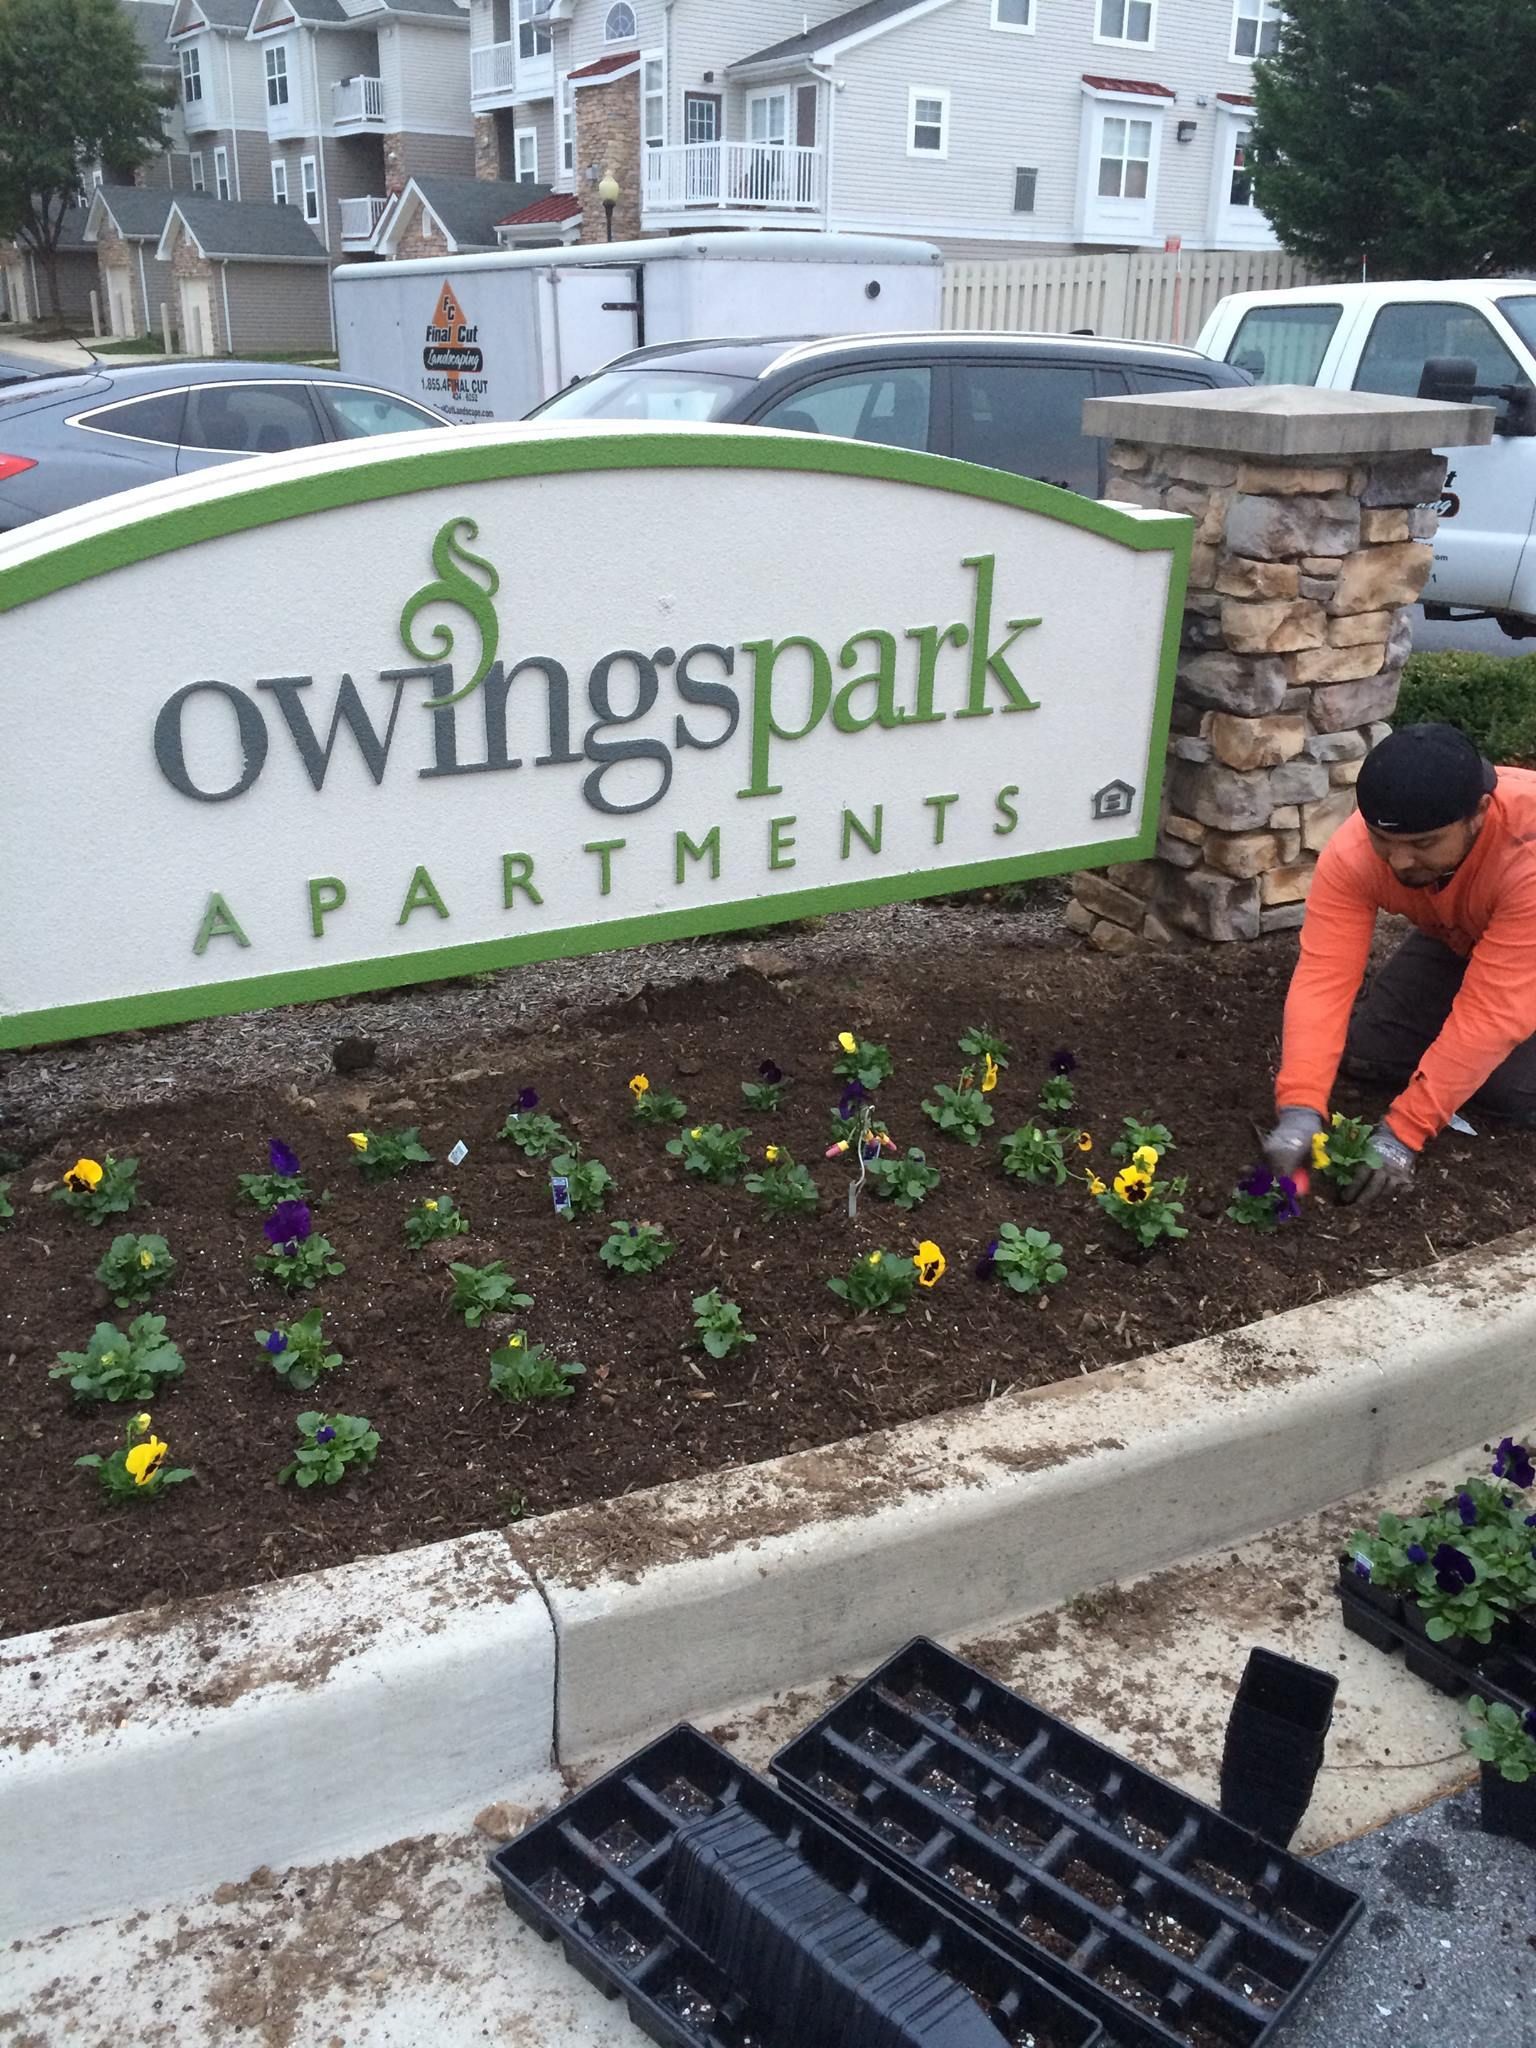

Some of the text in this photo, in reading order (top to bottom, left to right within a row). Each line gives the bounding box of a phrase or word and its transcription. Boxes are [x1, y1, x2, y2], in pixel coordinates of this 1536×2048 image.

[426, 325, 478, 342] Final Cut
[427, 349, 479, 371] Landscaping
[472, 380, 488, 394] CUT
[193, 785, 1019, 954] APARTMENTS
